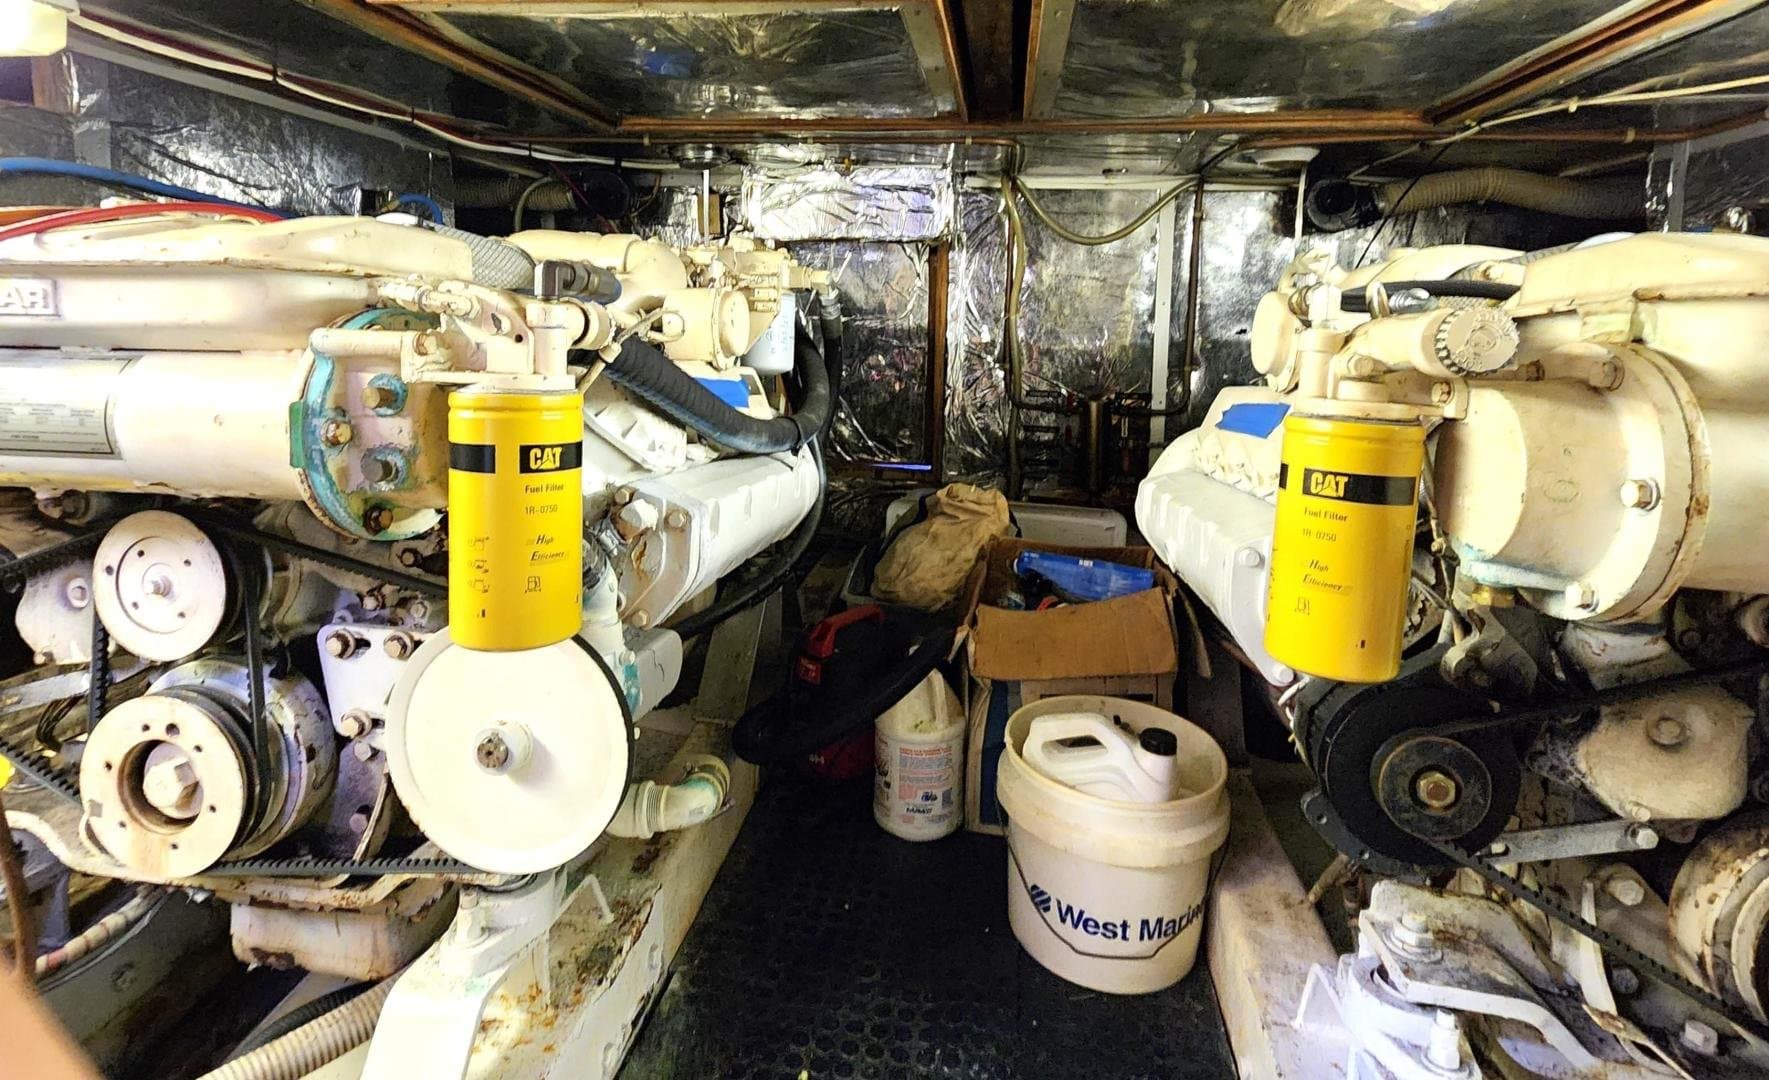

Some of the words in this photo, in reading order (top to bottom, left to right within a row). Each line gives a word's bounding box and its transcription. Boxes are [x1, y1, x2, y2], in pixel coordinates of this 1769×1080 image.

[529, 447, 563, 470] CAT
[525, 484, 543, 494] Fuel
[545, 483, 564, 493] Filter
[1310, 471, 1349, 498] CAT
[1303, 506, 1322, 519] Fuel
[1323, 510, 1348, 522] Filter
[535, 534, 554, 545] High
[1309, 559, 1329, 573] High
[1302, 573, 1343, 591] Efficiency
[1055, 898, 1130, 942] West
